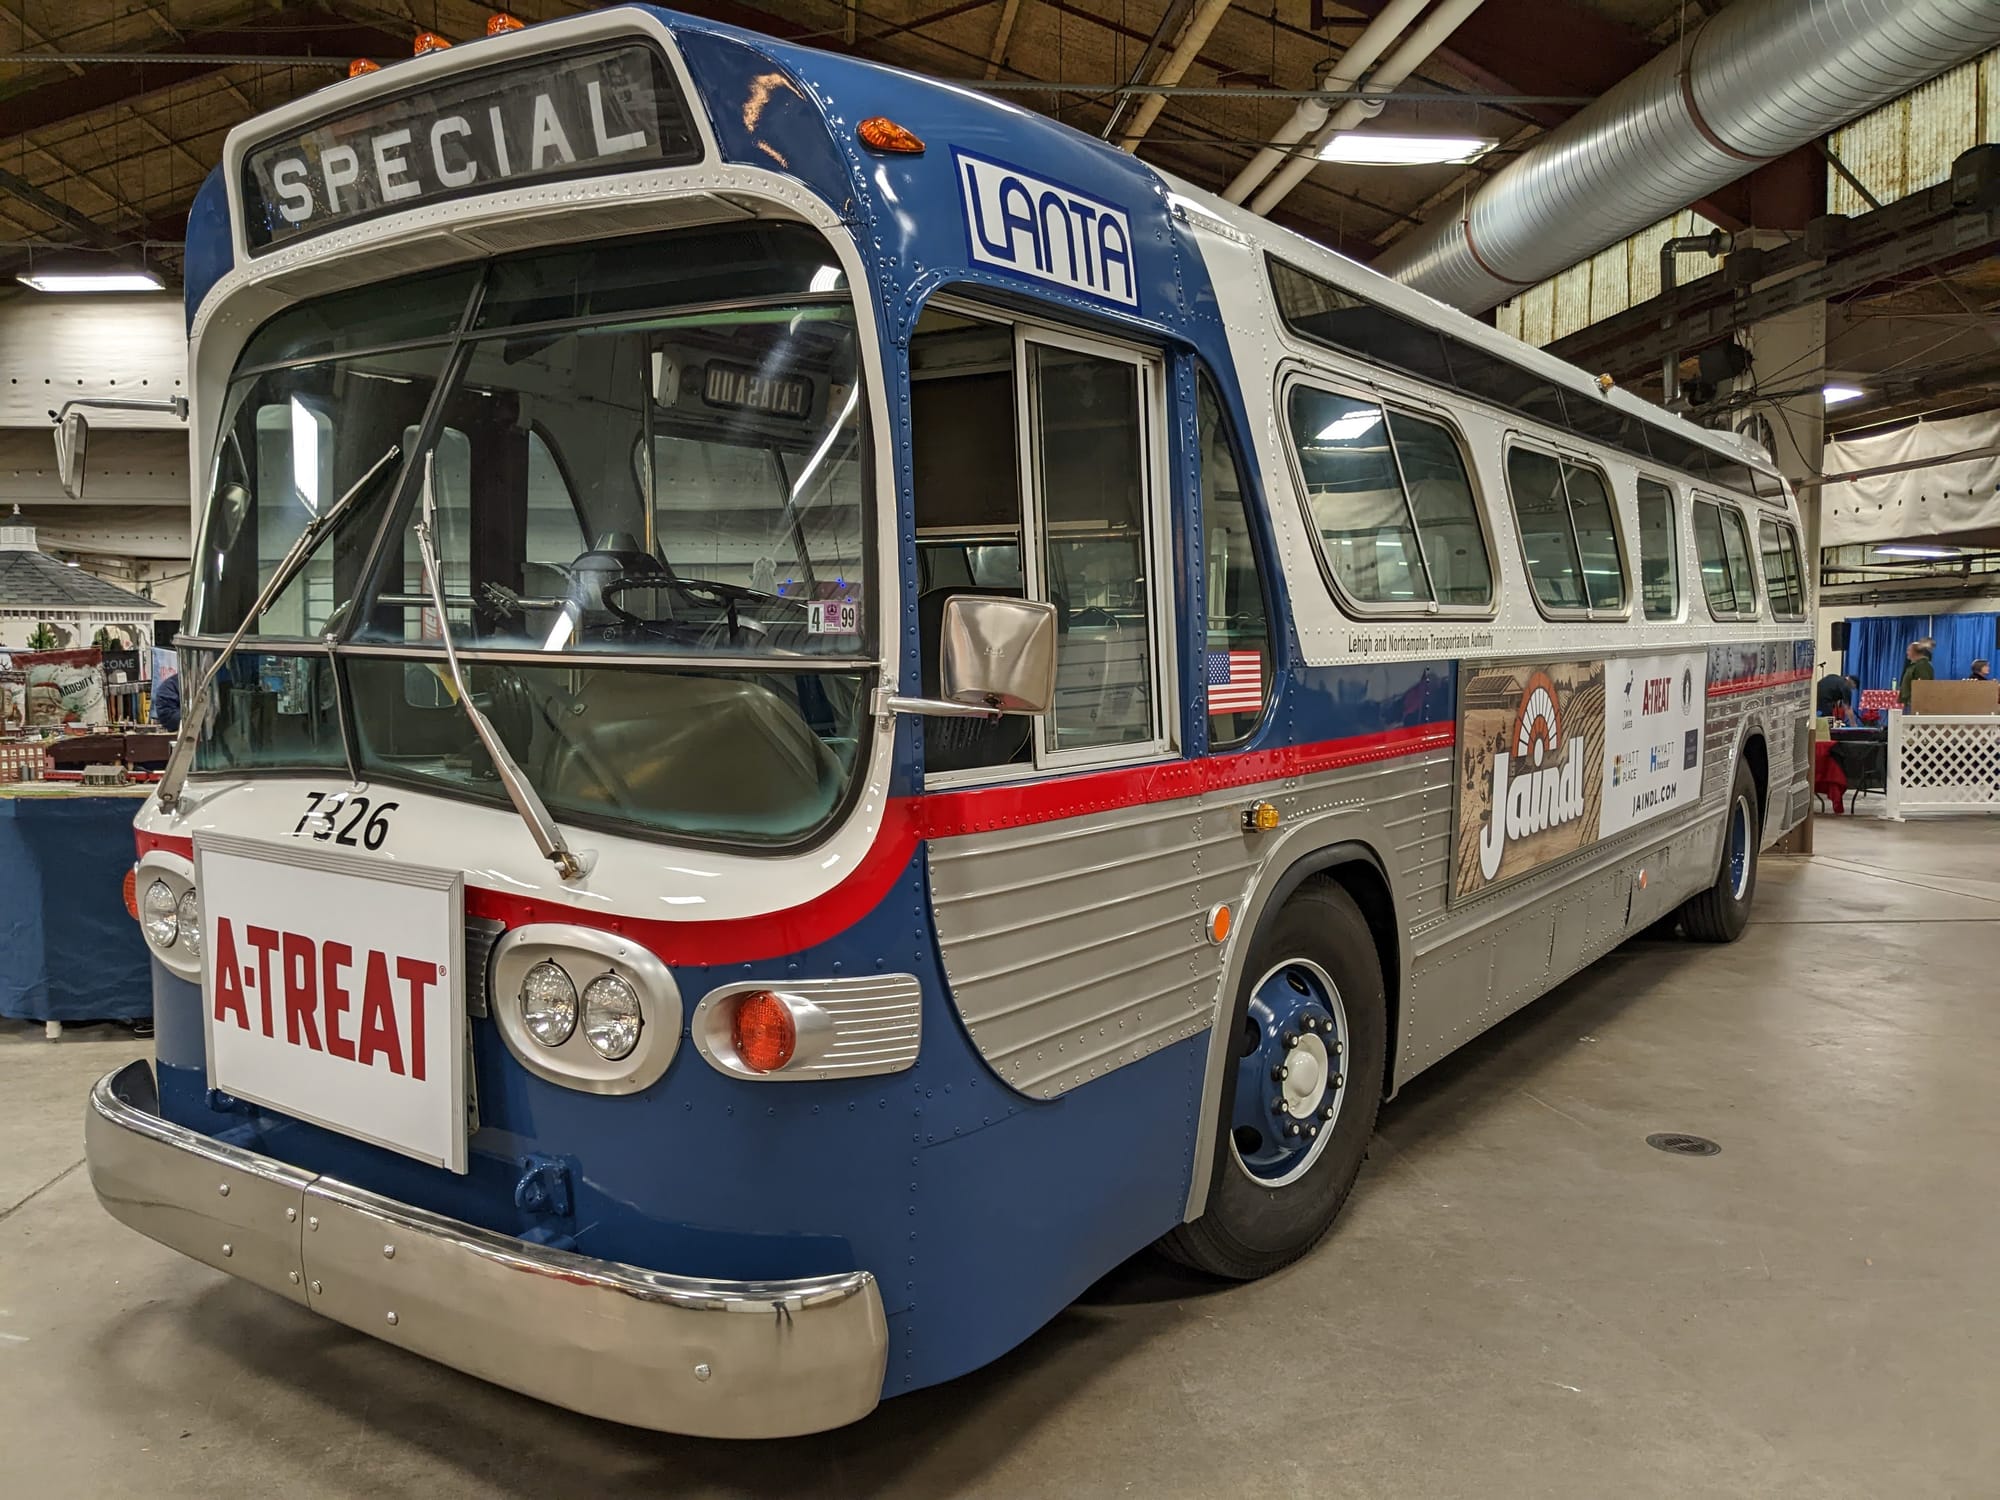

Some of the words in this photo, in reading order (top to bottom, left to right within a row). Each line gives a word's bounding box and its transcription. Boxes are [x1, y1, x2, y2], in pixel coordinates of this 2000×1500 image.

[275, 80, 648, 224] SPECIAL
[965, 163, 1133, 299] LANTA
[811, 606, 821, 632] 4
[841, 607, 855, 628] 99
[1348, 634, 1373, 656] Lehigh
[1374, 634, 1387, 652] and
[1389, 634, 1429, 654] Northampton
[1430, 633, 1470, 652] Transportation
[1471, 632, 1494, 650] Authority
[1642, 677, 1672, 716] A-TREAT
[292, 791, 400, 851] 7326
[1479, 736, 1585, 881] Jaindl
[1632, 781, 1677, 818] JAINDL.COM
